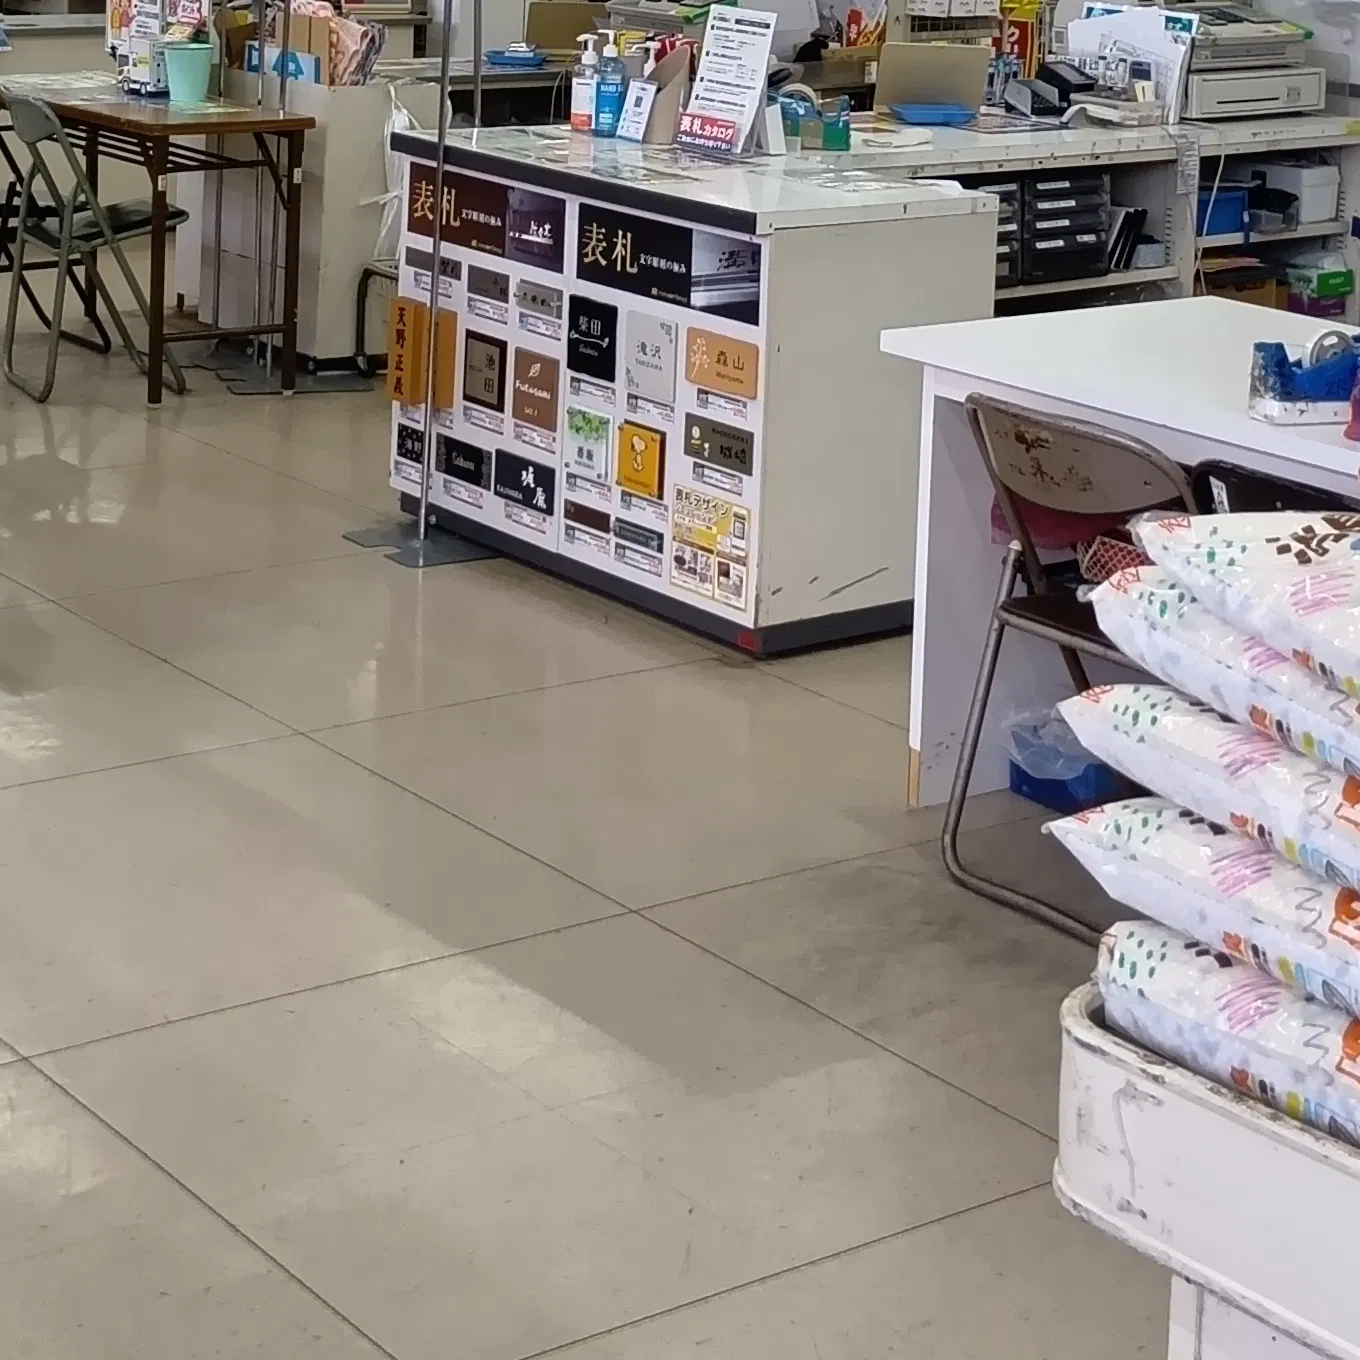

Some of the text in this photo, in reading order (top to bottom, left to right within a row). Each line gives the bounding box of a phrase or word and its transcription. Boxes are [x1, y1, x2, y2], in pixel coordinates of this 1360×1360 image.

[679, 114, 735, 141] 表札カタログ
[411, 178, 462, 229] 表札
[580, 221, 639, 277] 表札
[715, 349, 746, 372] 森山
